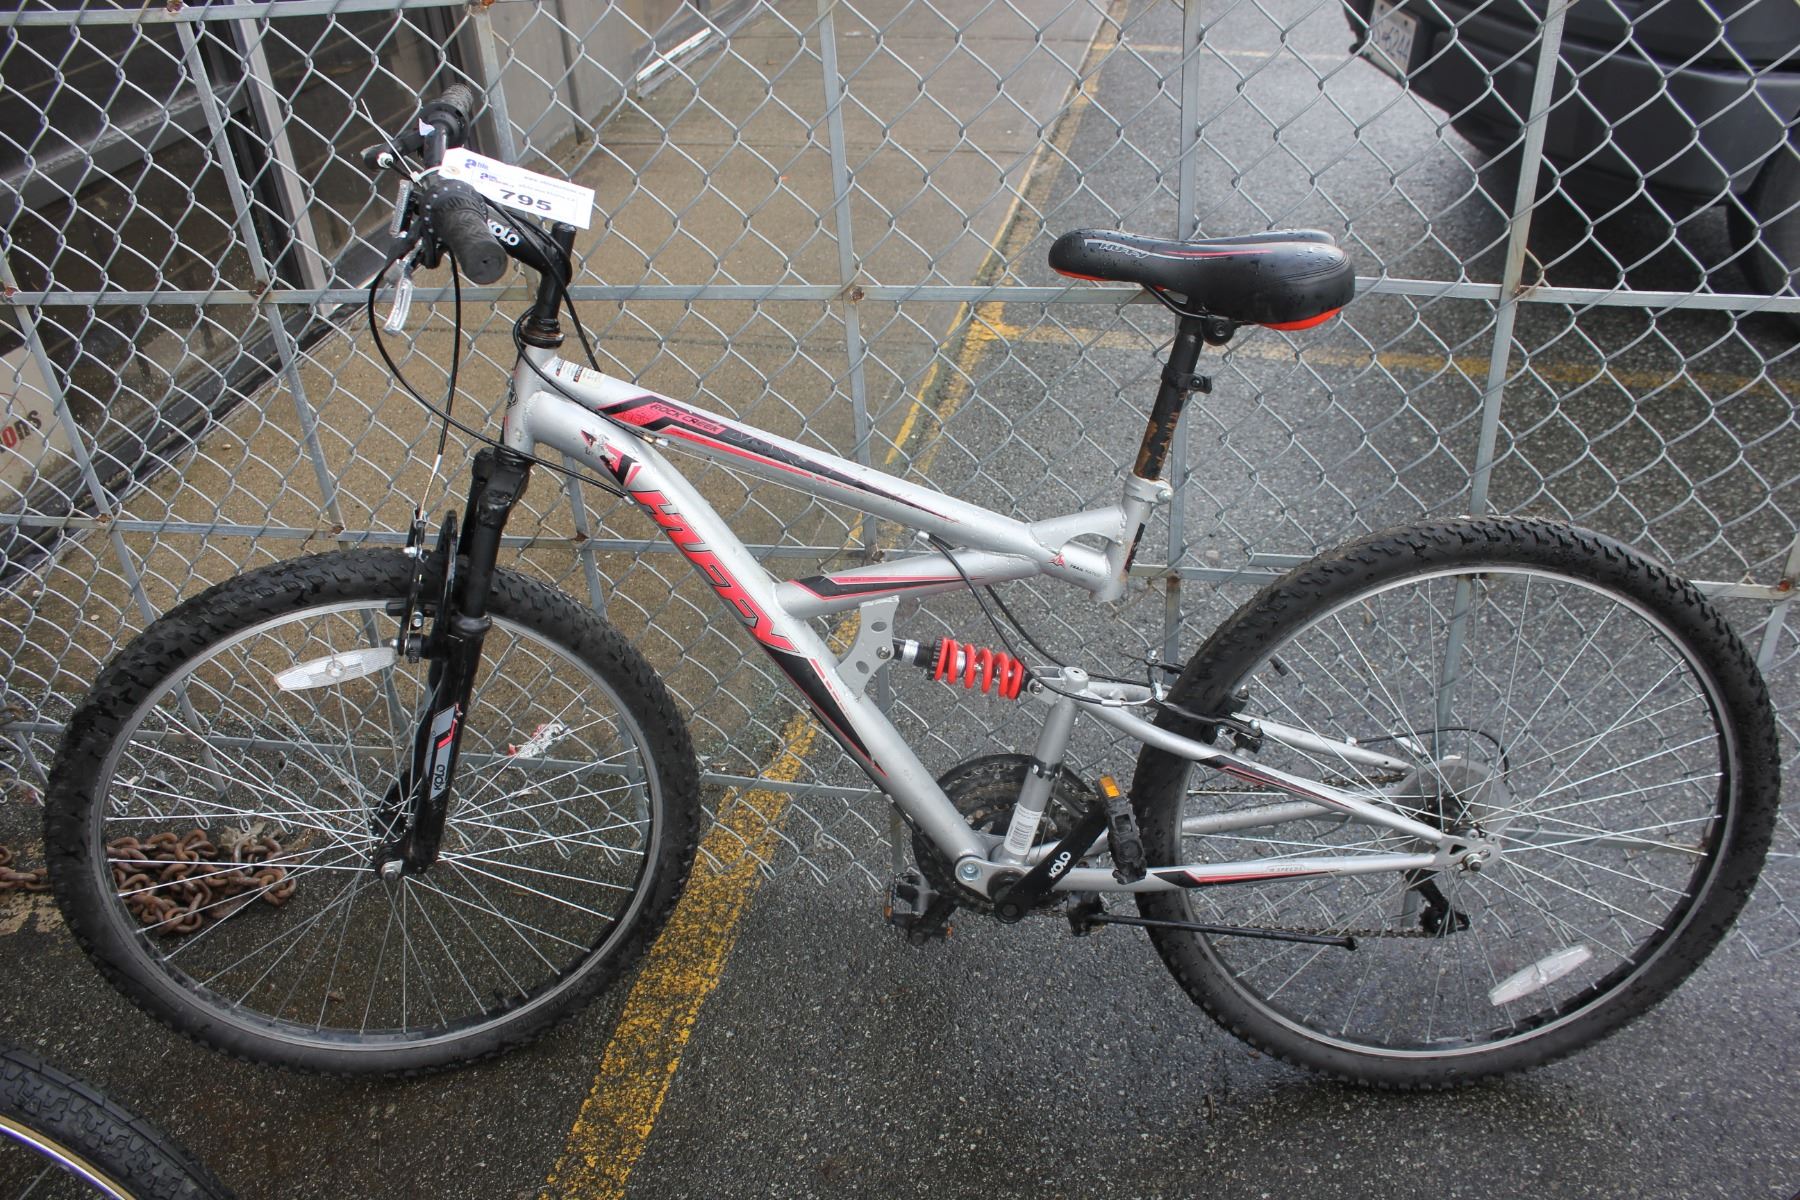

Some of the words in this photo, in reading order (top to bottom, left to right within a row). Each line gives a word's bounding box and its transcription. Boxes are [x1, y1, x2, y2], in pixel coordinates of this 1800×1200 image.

[500, 188, 552, 211] 795
[0, 410, 42, 453] ons
[650, 403, 682, 418] ROCK
[682, 413, 720, 433] CREEK
[627, 490, 800, 653] HUFFY
[434, 764, 446, 791] KOLO
[1049, 851, 1071, 879] KOLO
